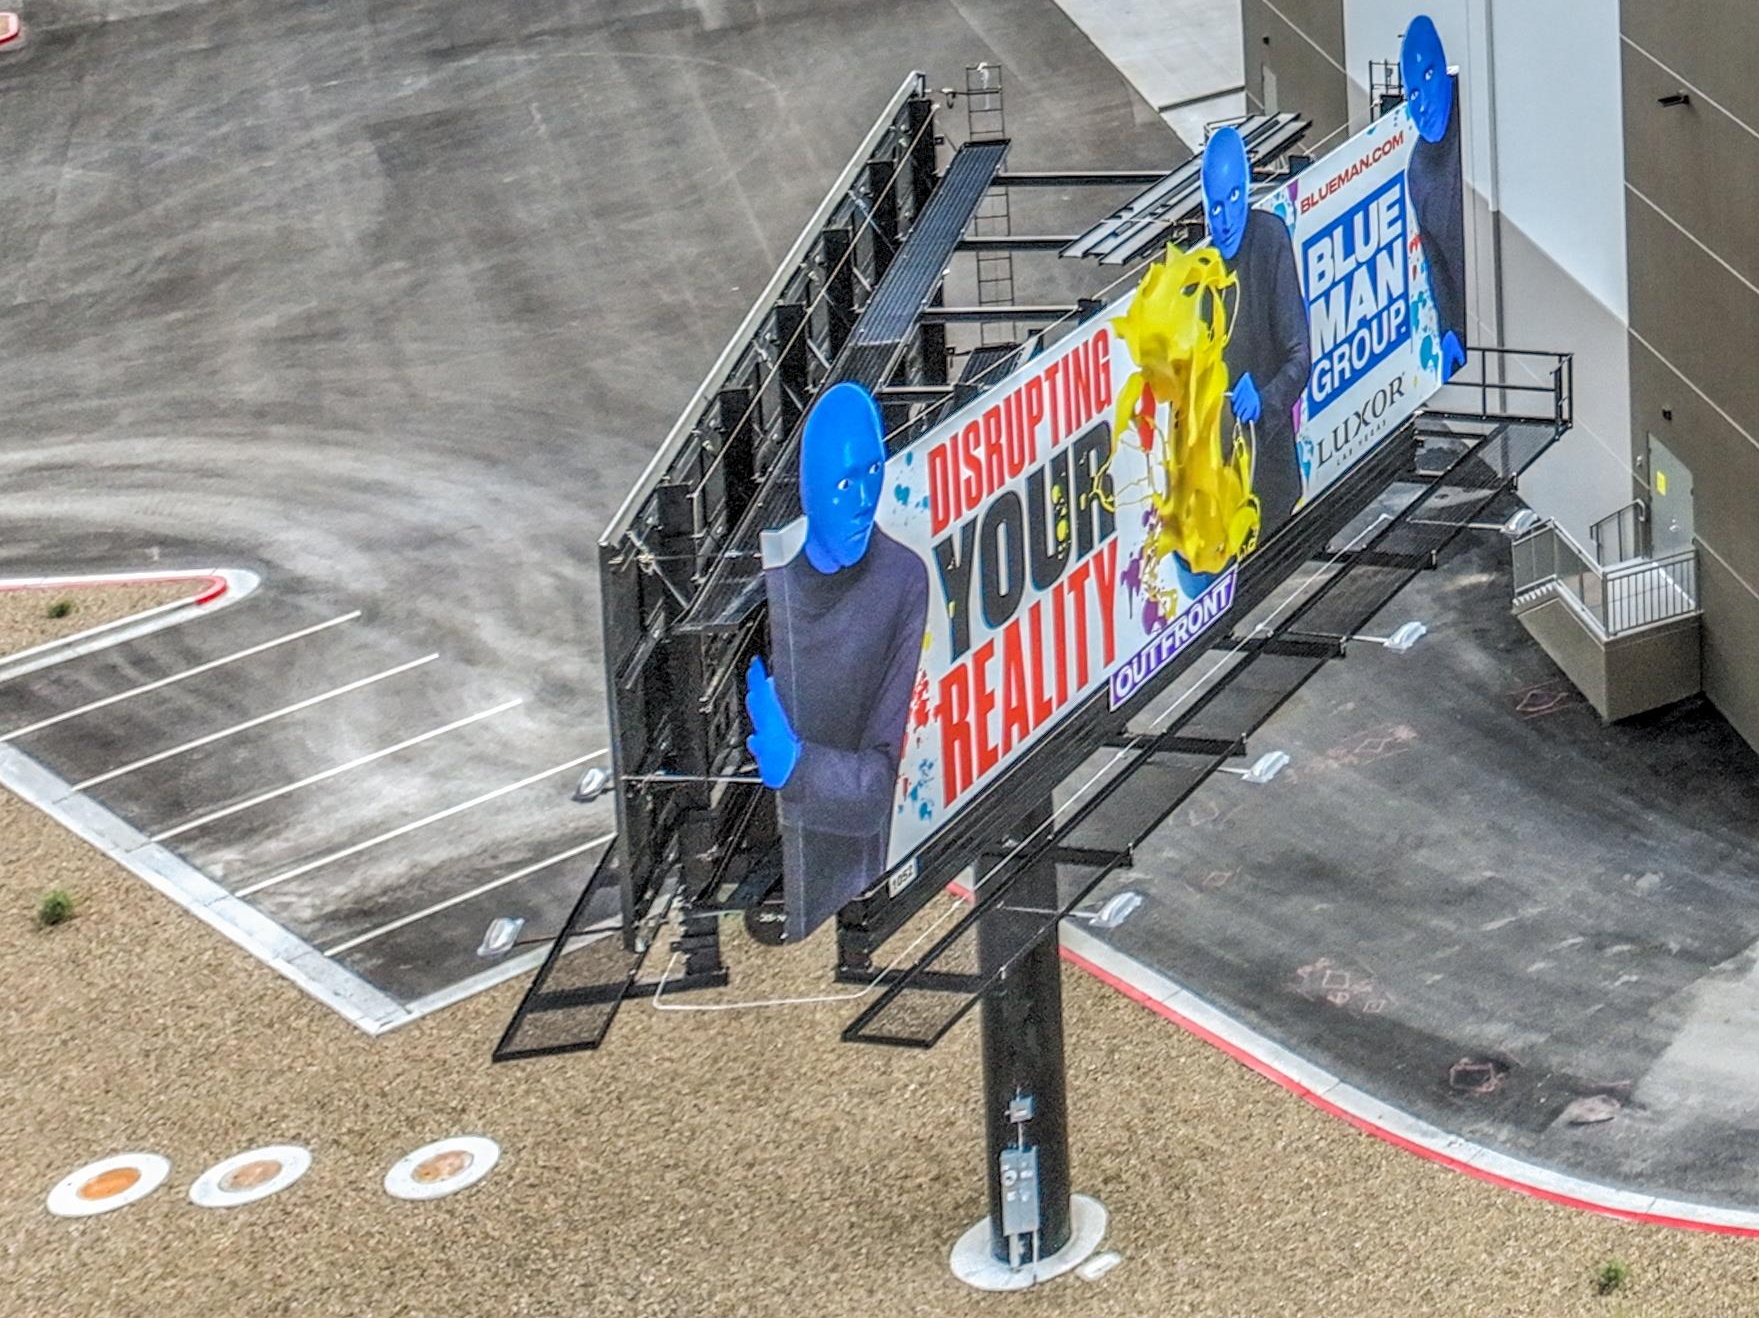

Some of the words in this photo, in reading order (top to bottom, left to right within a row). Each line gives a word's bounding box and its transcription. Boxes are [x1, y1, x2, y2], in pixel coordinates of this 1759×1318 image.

[1299, 130, 1405, 216] BLUEMAN.COM
[1307, 182, 1403, 300] BLUE
[1309, 236, 1405, 364] MAN
[926, 327, 1113, 539] DISRUPTING
[1316, 374, 1406, 470] LUXOR
[931, 419, 1118, 665] YOUR
[935, 536, 1119, 810] REALITY
[1115, 573, 1235, 699] OUTFRONT
